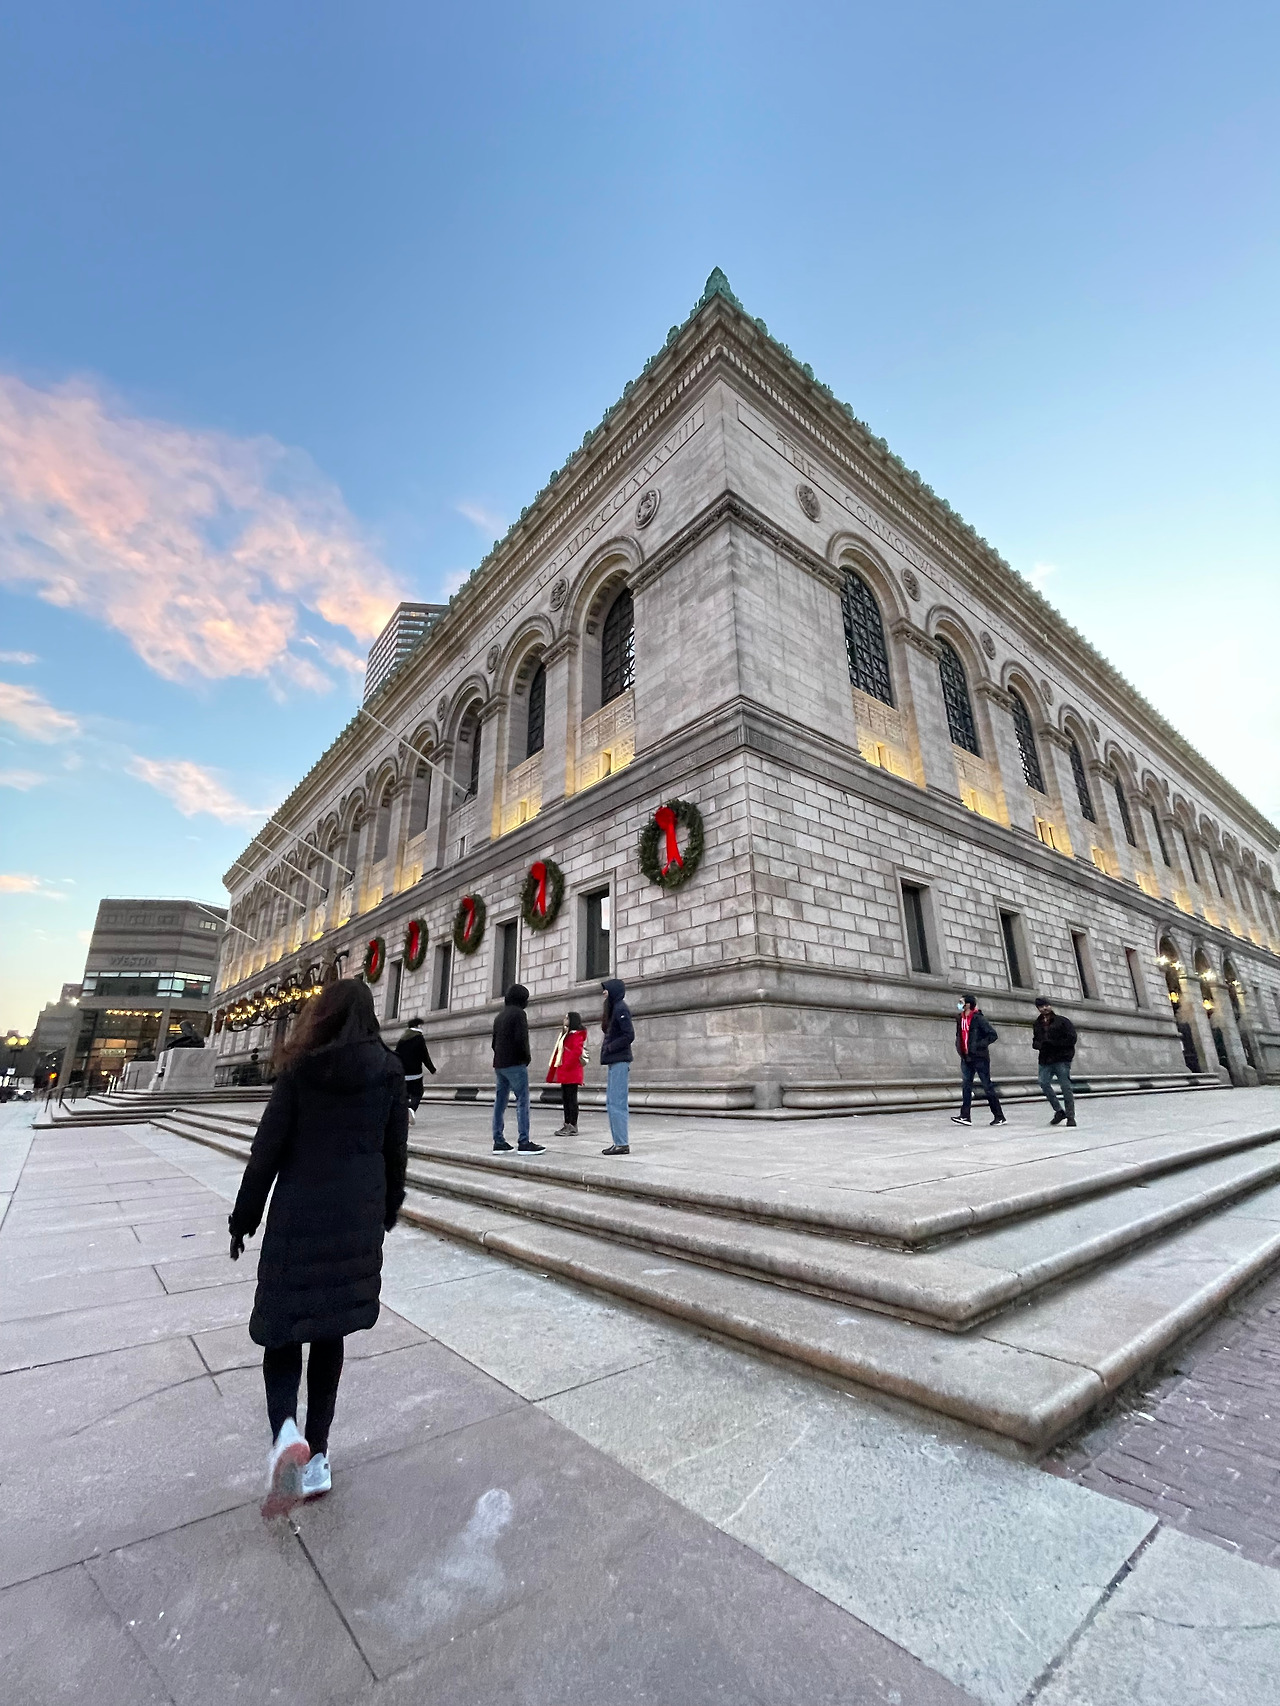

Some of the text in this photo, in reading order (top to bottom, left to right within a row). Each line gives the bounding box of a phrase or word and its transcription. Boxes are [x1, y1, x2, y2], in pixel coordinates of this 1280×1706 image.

[776, 431, 819, 484] THE
[844, 496, 971, 609] COMMONWEALTH
[110, 955, 158, 967] WESTIN
